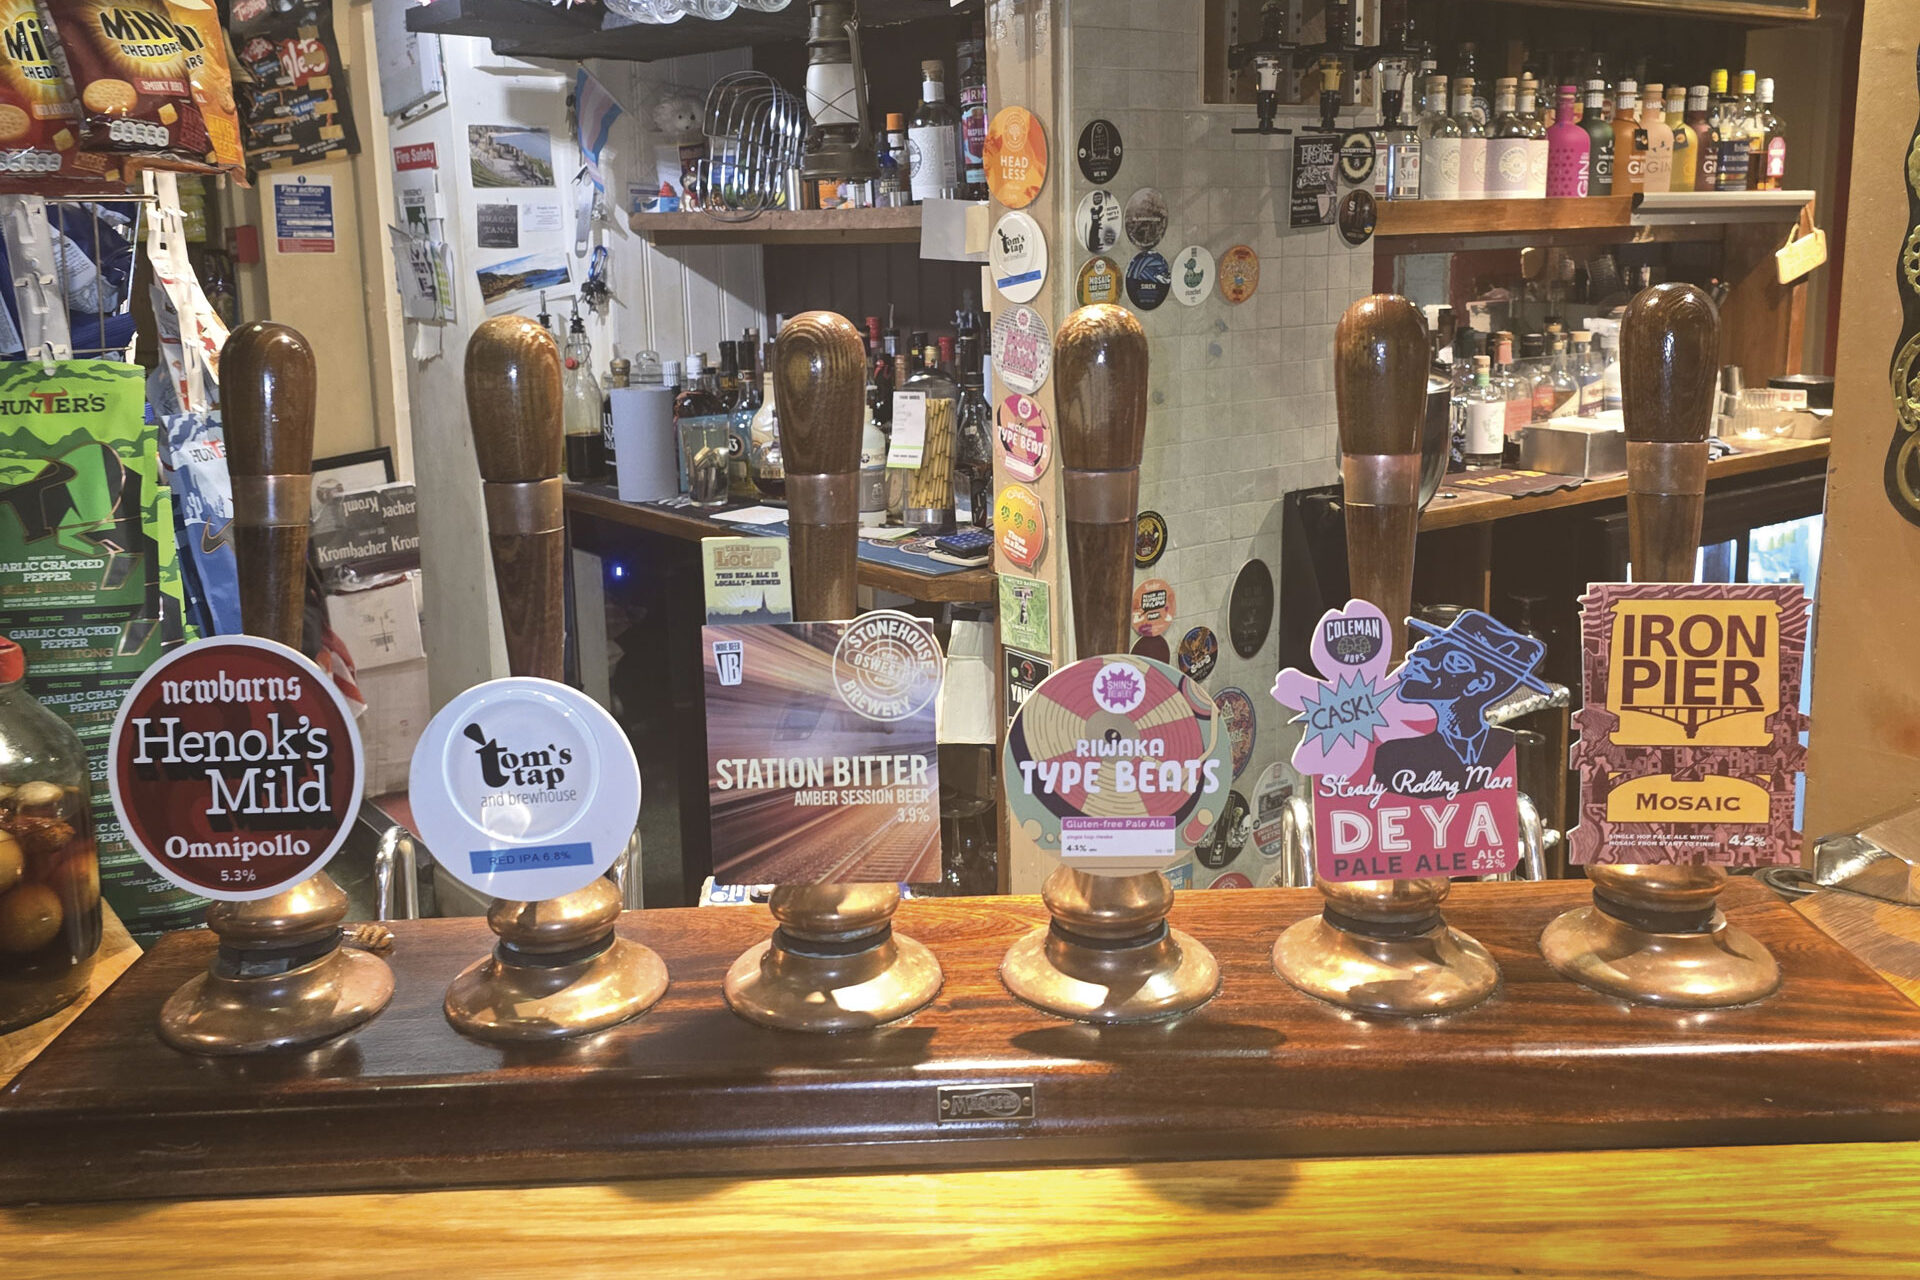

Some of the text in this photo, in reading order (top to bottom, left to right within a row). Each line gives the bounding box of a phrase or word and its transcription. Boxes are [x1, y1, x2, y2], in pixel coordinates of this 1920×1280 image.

[22, 65, 60, 79] CHEDD
[396, 148, 434, 165] Fire Safety
[1000, 155, 1029, 168] HEAD
[1002, 168, 1026, 180] LESS
[1596, 161, 1611, 174] GI
[1627, 160, 1644, 174] GI
[1703, 160, 1717, 173] GI
[1577, 160, 1590, 198] GIN
[281, 185, 297, 193] Fire
[1001, 233, 1025, 253] tom's
[1010, 243, 1024, 253] tap
[997, 425, 1049, 458] TYPE BEATS
[40, 559, 104, 570] CRACKED
[23, 571, 72, 582] PEPPER
[9, 626, 121, 640] GARLIC CRACKED
[1326, 619, 1380, 641] COLEMAN
[1623, 614, 1767, 658] IRON
[40, 638, 88, 649] PEPPER
[728, 642, 741, 651] BEER
[848, 620, 935, 670] STONEHOUSE
[1343, 653, 1366, 662] HOPS
[161, 670, 301, 705] newbarns
[1107, 680, 1133, 690] SHINY
[1620, 659, 1764, 706] PIER
[38, 689, 130, 704] GARLIC CRACK
[842, 680, 911, 716] BREWERY
[69, 700, 118, 713] PEPPER
[1311, 694, 1376, 730] CASK!
[84, 710, 120, 721] BILTO
[131, 713, 329, 764] Henok's
[1076, 738, 1165, 758] RIWAKA
[472, 730, 573, 788] tom's
[511, 766, 565, 790] tap
[716, 754, 928, 790] STATION BITTER
[1019, 759, 1221, 794] TYPE BEATS
[205, 764, 331, 815] Mild
[1319, 765, 1513, 809] Steady Rolling Man
[480, 788, 577, 808] and brewhouse
[794, 788, 929, 807] AMBER SESSION BEER
[897, 807, 930, 823] 3.9%
[1066, 820, 1166, 829] Gluten-free Pale Ale
[1330, 802, 1503, 854] DEYA
[95, 832, 125, 843] PEPP
[1729, 834, 1766, 847] 4.2%
[165, 834, 311, 862] Omnipollo
[1477, 849, 1505, 859] ALC
[489, 851, 571, 866] RED IPA 6.8%
[1334, 852, 1467, 877] PALE ALE
[1471, 859, 1506, 870] 5.2%
[220, 870, 256, 882] 5.3%
[147, 881, 175, 893] PEPP
